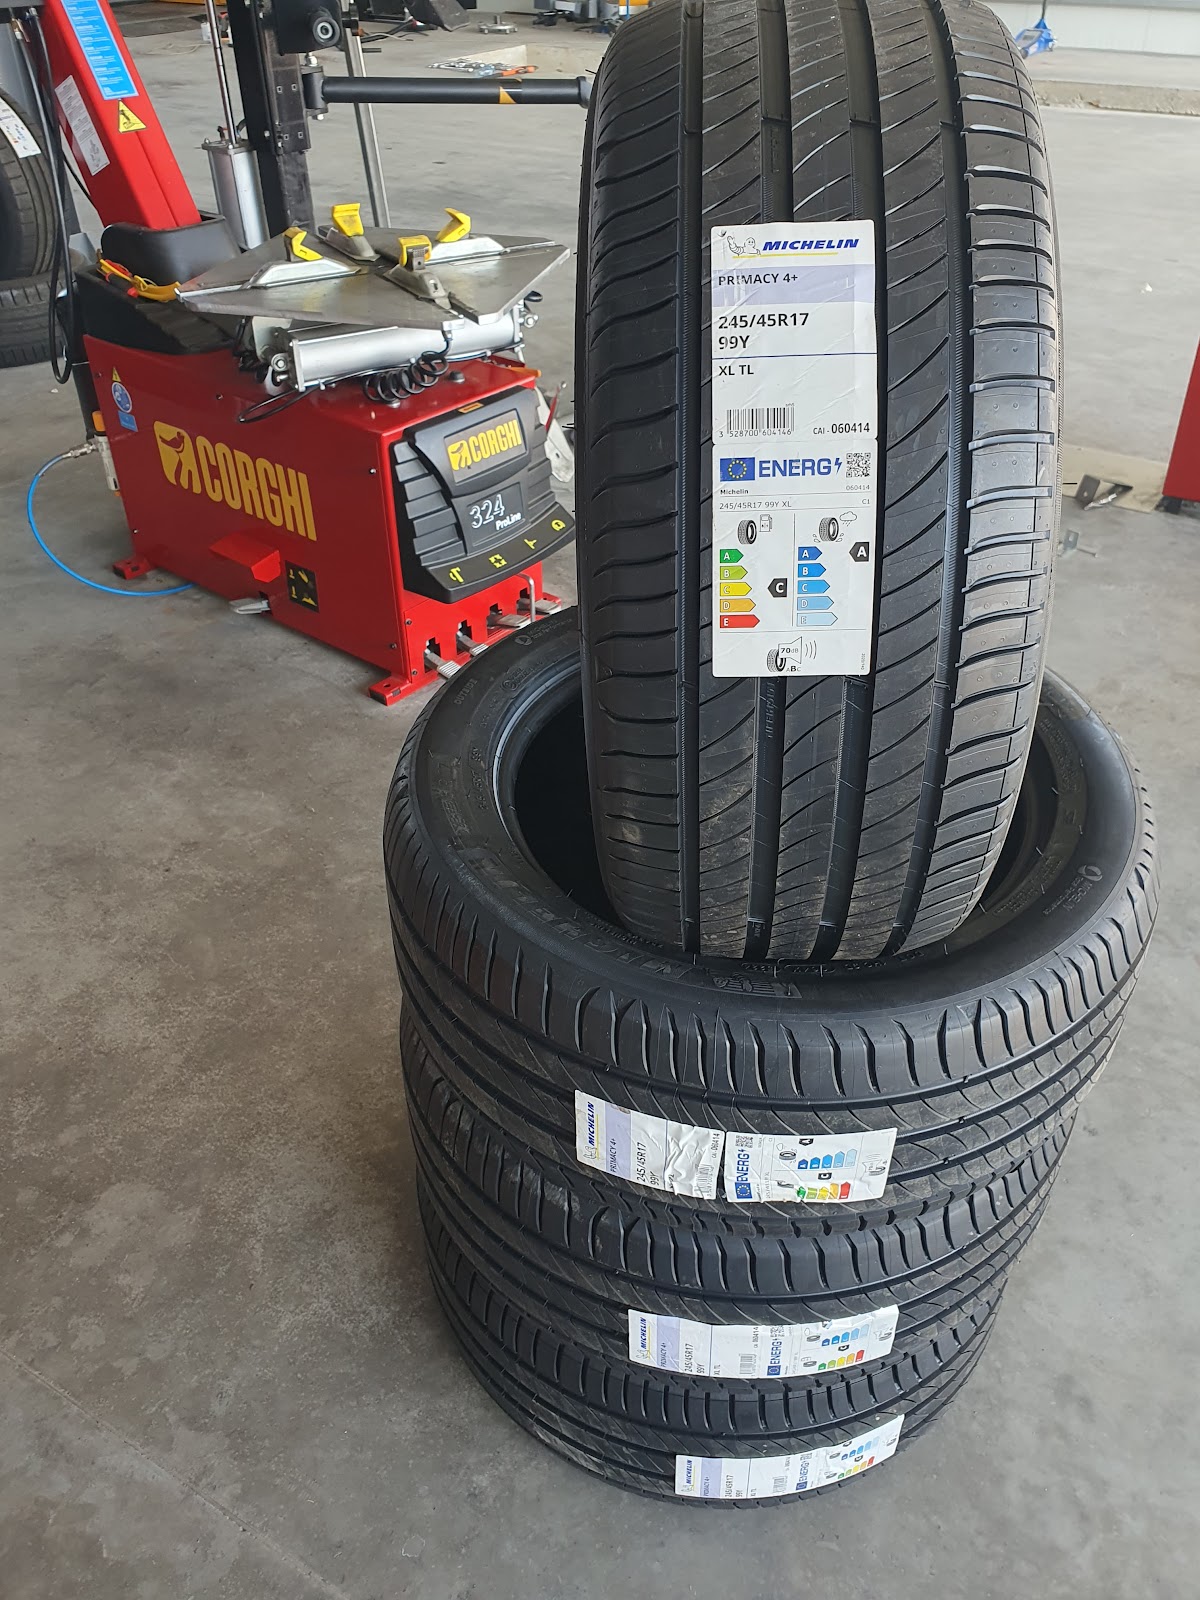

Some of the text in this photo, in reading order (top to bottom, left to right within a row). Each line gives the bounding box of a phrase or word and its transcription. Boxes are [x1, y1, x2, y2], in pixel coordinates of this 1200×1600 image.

[762, 238, 860, 251] MICHELIN
[718, 272, 799, 286] PRIMACY 4+
[718, 312, 809, 330] 245/45R17
[718, 335, 750, 350] 99Y
[718, 364, 755, 377] XL TL
[719, 428, 792, 438] 3 528700 604146
[812, 427, 825, 435] CAI
[831, 422, 870, 434] 060414
[469, 419, 522, 463] CORGHI
[758, 458, 832, 478] ENERG
[195, 435, 317, 542] CORGHI
[469, 494, 505, 529] 324
[719, 500, 792, 510] 245/45R17 99Y XL
[495, 510, 522, 531] ProLine
[723, 552, 731, 561] A
[802, 550, 810, 558] A
[857, 546, 867, 558] A
[723, 569, 730, 578] B
[802, 566, 809, 575] B
[723, 586, 730, 595] C
[775, 582, 785, 594] C
[802, 583, 808, 592] C
[723, 602, 730, 610] D
[801, 600, 808, 608] D
[723, 618, 729, 626] E
[587, 1101, 595, 1146] MICHELIN
[609, 1146, 617, 1173] PRIMACY
[636, 1142, 646, 1183] 245/45R17
[736, 1153, 750, 1182] ENERG
[650, 1171, 659, 1186] 99Y
[639, 1316, 647, 1350] MICHELIN
[770, 1341, 782, 1365] ENERG
[685, 1459, 693, 1485] MICHELIN
